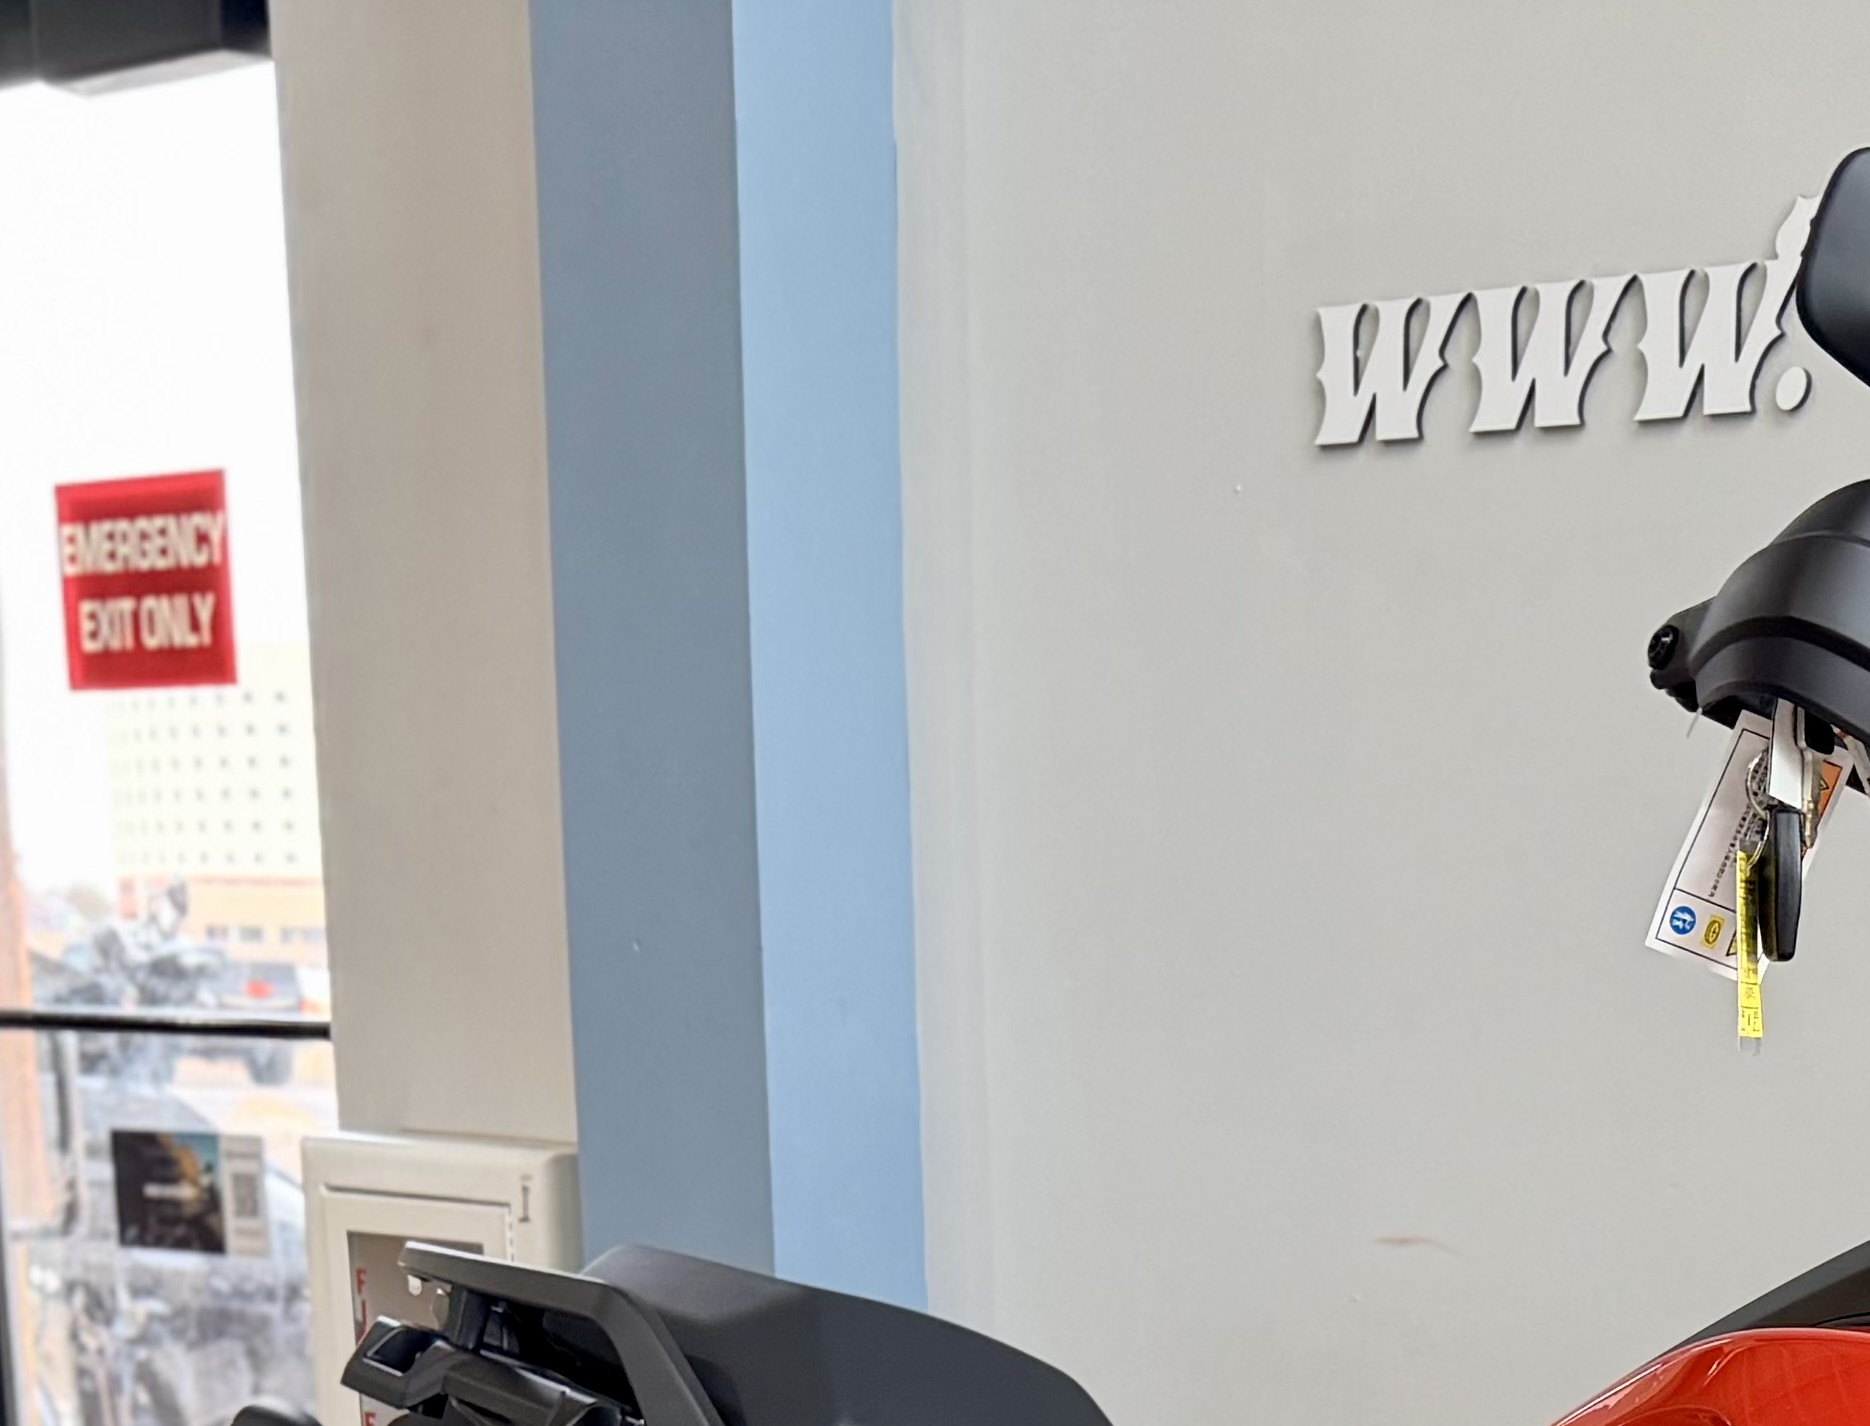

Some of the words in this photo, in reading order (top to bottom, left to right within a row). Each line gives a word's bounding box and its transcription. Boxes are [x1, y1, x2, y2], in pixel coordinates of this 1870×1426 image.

[62, 511, 226, 577] EMERGENCY
[79, 597, 139, 654] EXIT
[139, 592, 217, 651] ONLY
